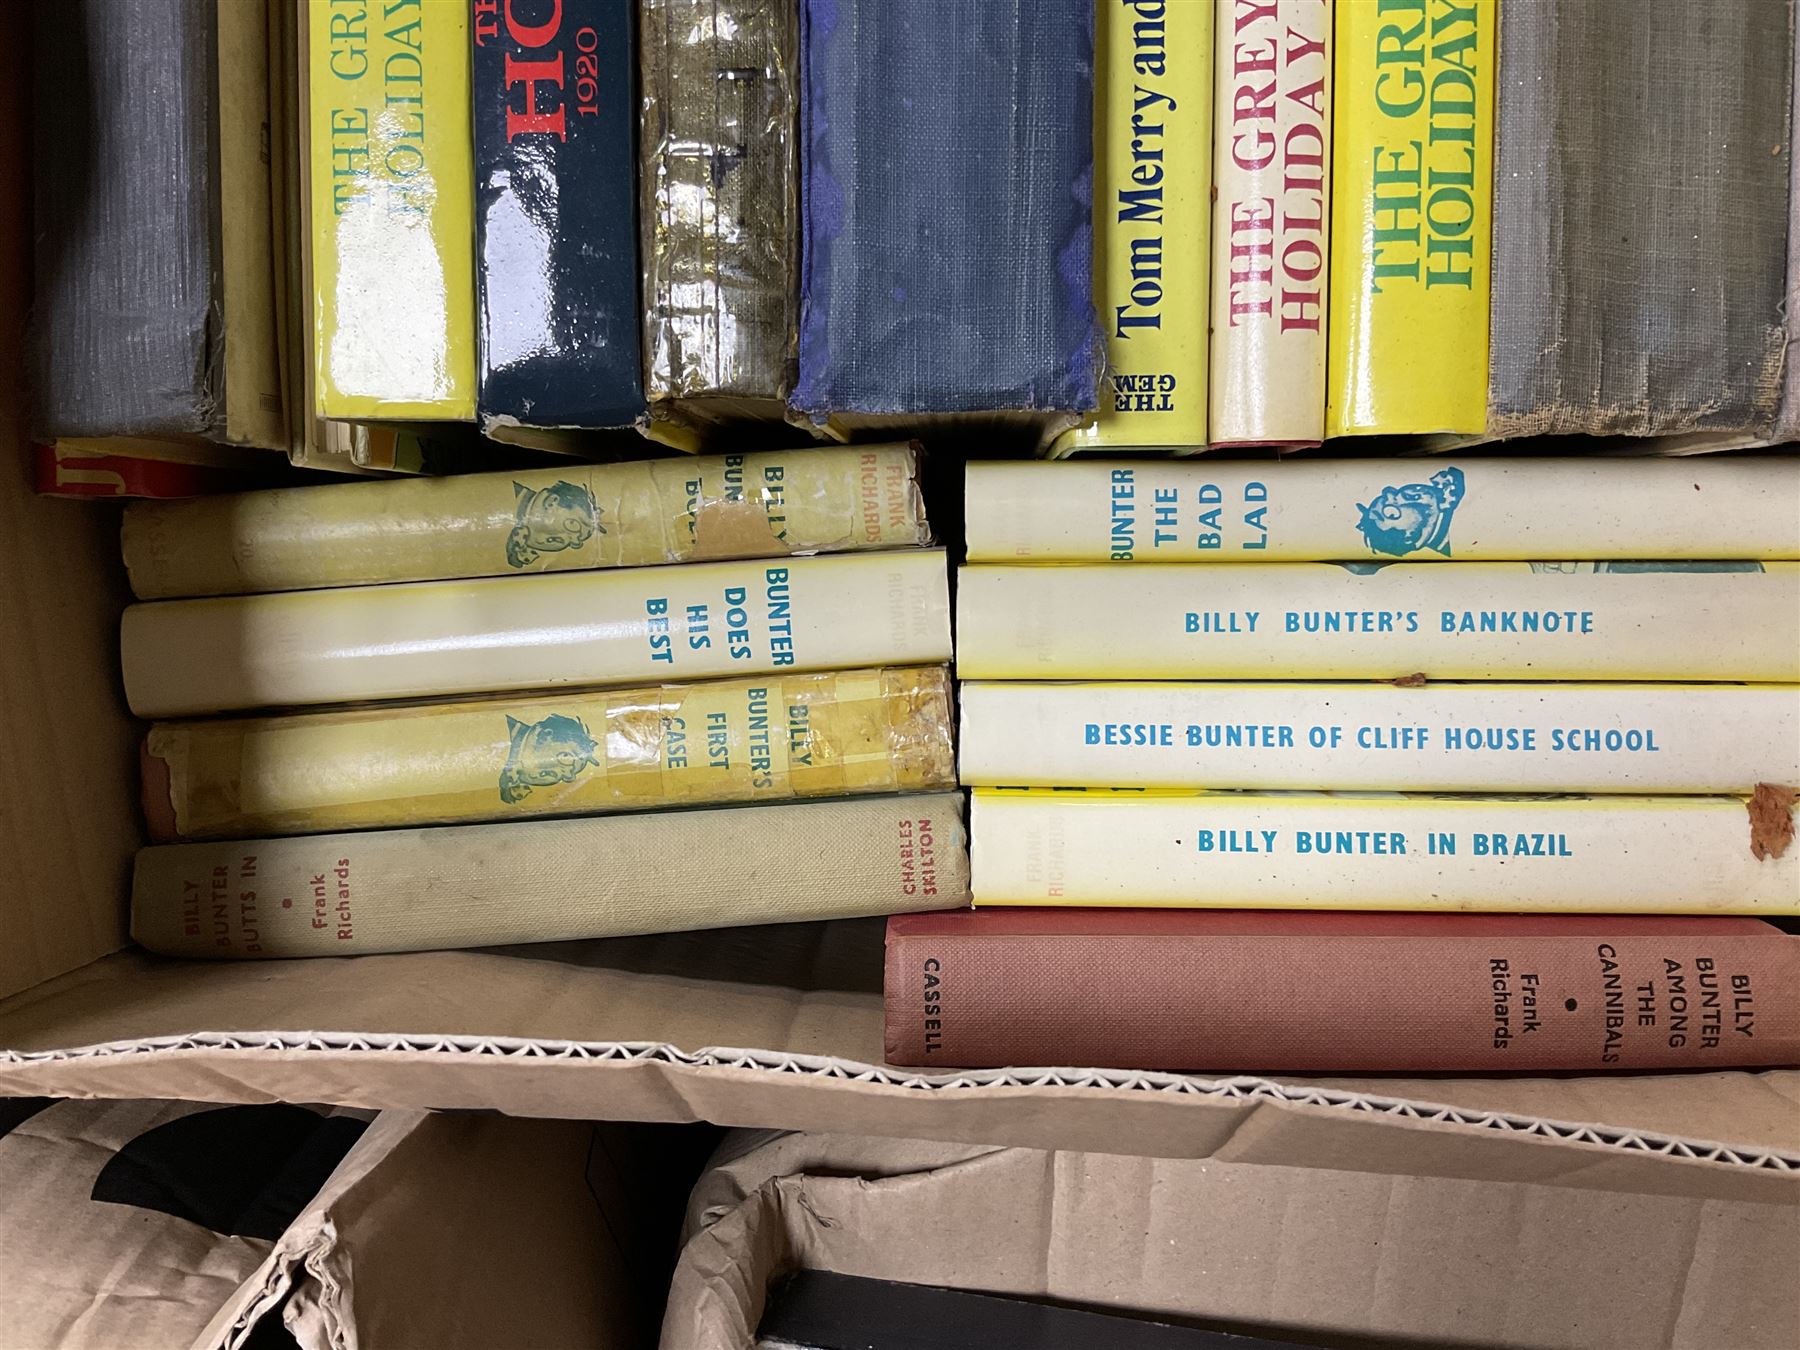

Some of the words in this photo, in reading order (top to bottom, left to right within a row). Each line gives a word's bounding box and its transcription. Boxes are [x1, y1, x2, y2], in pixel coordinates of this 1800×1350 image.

[575, 27, 599, 117] 1920
[1122, 0, 1167, 76] and
[332, 108, 371, 215] THE
[1118, 85, 1177, 224] Merry
[1281, 27, 1326, 335] HOLIDAY
[1426, 0, 1477, 291] HOLIDAY
[1371, 140, 1422, 293] THE
[1116, 237, 1163, 339] Tom
[1230, 198, 1275, 327] THE
[1113, 374, 1176, 393] GEM
[1115, 394, 1174, 412] THE
[860, 454, 881, 544] RICHARDS
[886, 465, 905, 529] FRANK
[1111, 469, 1135, 561] BUNTER
[1155, 488, 1178, 547] THE
[1198, 484, 1222, 549] BAD
[1243, 481, 1268, 550] LAD
[646, 598, 673, 664] BEST
[686, 604, 711, 650] HIS
[725, 587, 751, 660] DOES
[766, 568, 795, 666] BUNTER
[1185, 612, 1260, 633] BILLY
[1285, 612, 1419, 633] BUNTER'S
[1441, 611, 1595, 634] BANKNOTE
[665, 717, 688, 769] CASE
[707, 712, 730, 770] FIRST
[748, 687, 772, 789] BUNTER'S
[788, 705, 812, 766] BILLY
[1085, 723, 1172, 746] BESSIE
[1188, 724, 1294, 747] BUNTER
[1308, 726, 1342, 748] OF
[1357, 727, 1429, 750] CLIFF
[1445, 728, 1537, 751] HOUSE
[1551, 729, 1660, 752] SCHOOL
[241, 856, 257, 879] IN
[899, 820, 916, 896] CHARLES
[919, 819, 937, 896] SKILTON
[1199, 830, 1278, 853] BILLY
[1296, 831, 1407, 855] BUNTER
[1428, 833, 1456, 855] IN
[1473, 833, 1573, 857] BRAZIL
[184, 880, 200, 936] BILLY
[212, 866, 231, 946] BUNTER
[241, 891, 262, 952] BUTTS
[310, 874, 328, 929] Frank
[334, 858, 353, 940] Richards
[924, 958, 941, 1053] CASSELL
[1490, 959, 1513, 1049] Richards
[1520, 974, 1541, 1033] Frank
[1597, 943, 1624, 1064] CANNIBALS
[1637, 981, 1655, 1026] THE
[1663, 958, 1688, 1048] AMONG
[1696, 957, 1721, 1049] BUNTER
[1731, 975, 1753, 1038] BILLY
